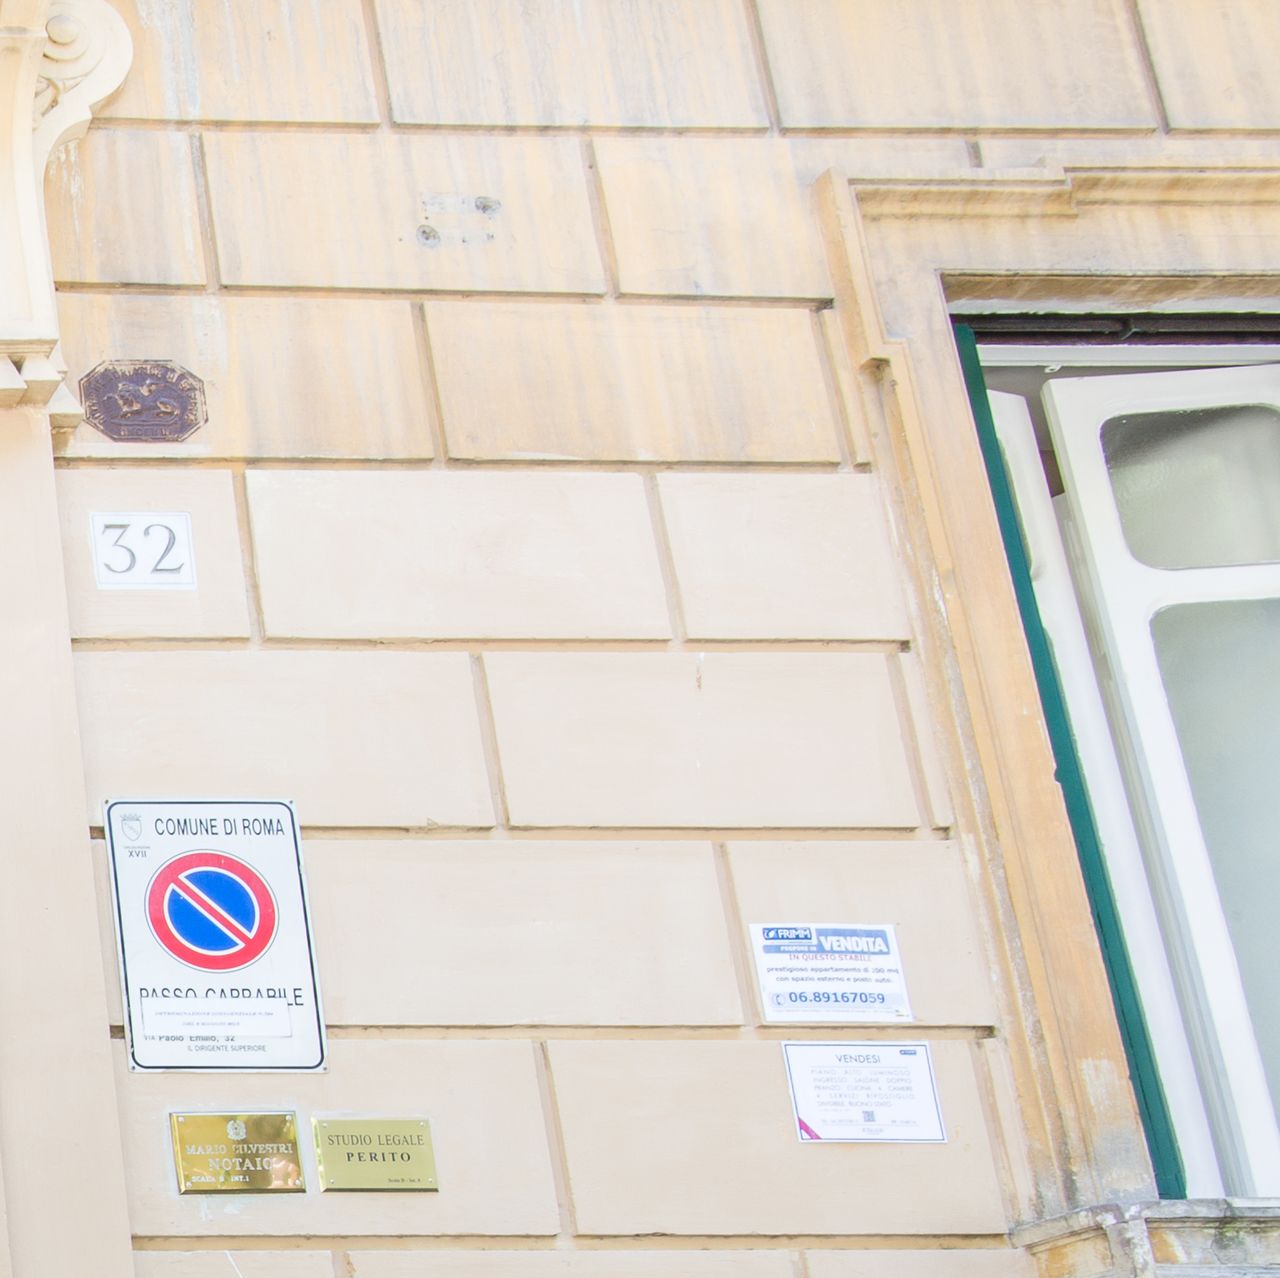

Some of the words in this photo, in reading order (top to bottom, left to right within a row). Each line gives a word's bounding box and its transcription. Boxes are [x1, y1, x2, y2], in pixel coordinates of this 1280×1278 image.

[102, 523, 185, 574] 32
[154, 818, 219, 836] COMUNE
[224, 818, 238, 836] DI
[244, 818, 285, 836] ROMA
[128, 850, 148, 858] XVII
[778, 929, 811, 939] FRIMM
[819, 936, 888, 952] VENDITA
[788, 992, 886, 1004] 06.89167059
[836, 1054, 881, 1064] VENDESI
[327, 1134, 372, 1146] STUDIO
[378, 1134, 425, 1146] LEGALE
[186, 1144, 227, 1155] MARIO
[232, 1144, 294, 1154] SILVESTRI
[346, 1151, 411, 1162] PERITO
[208, 1157, 273, 1170] NOTAIO
